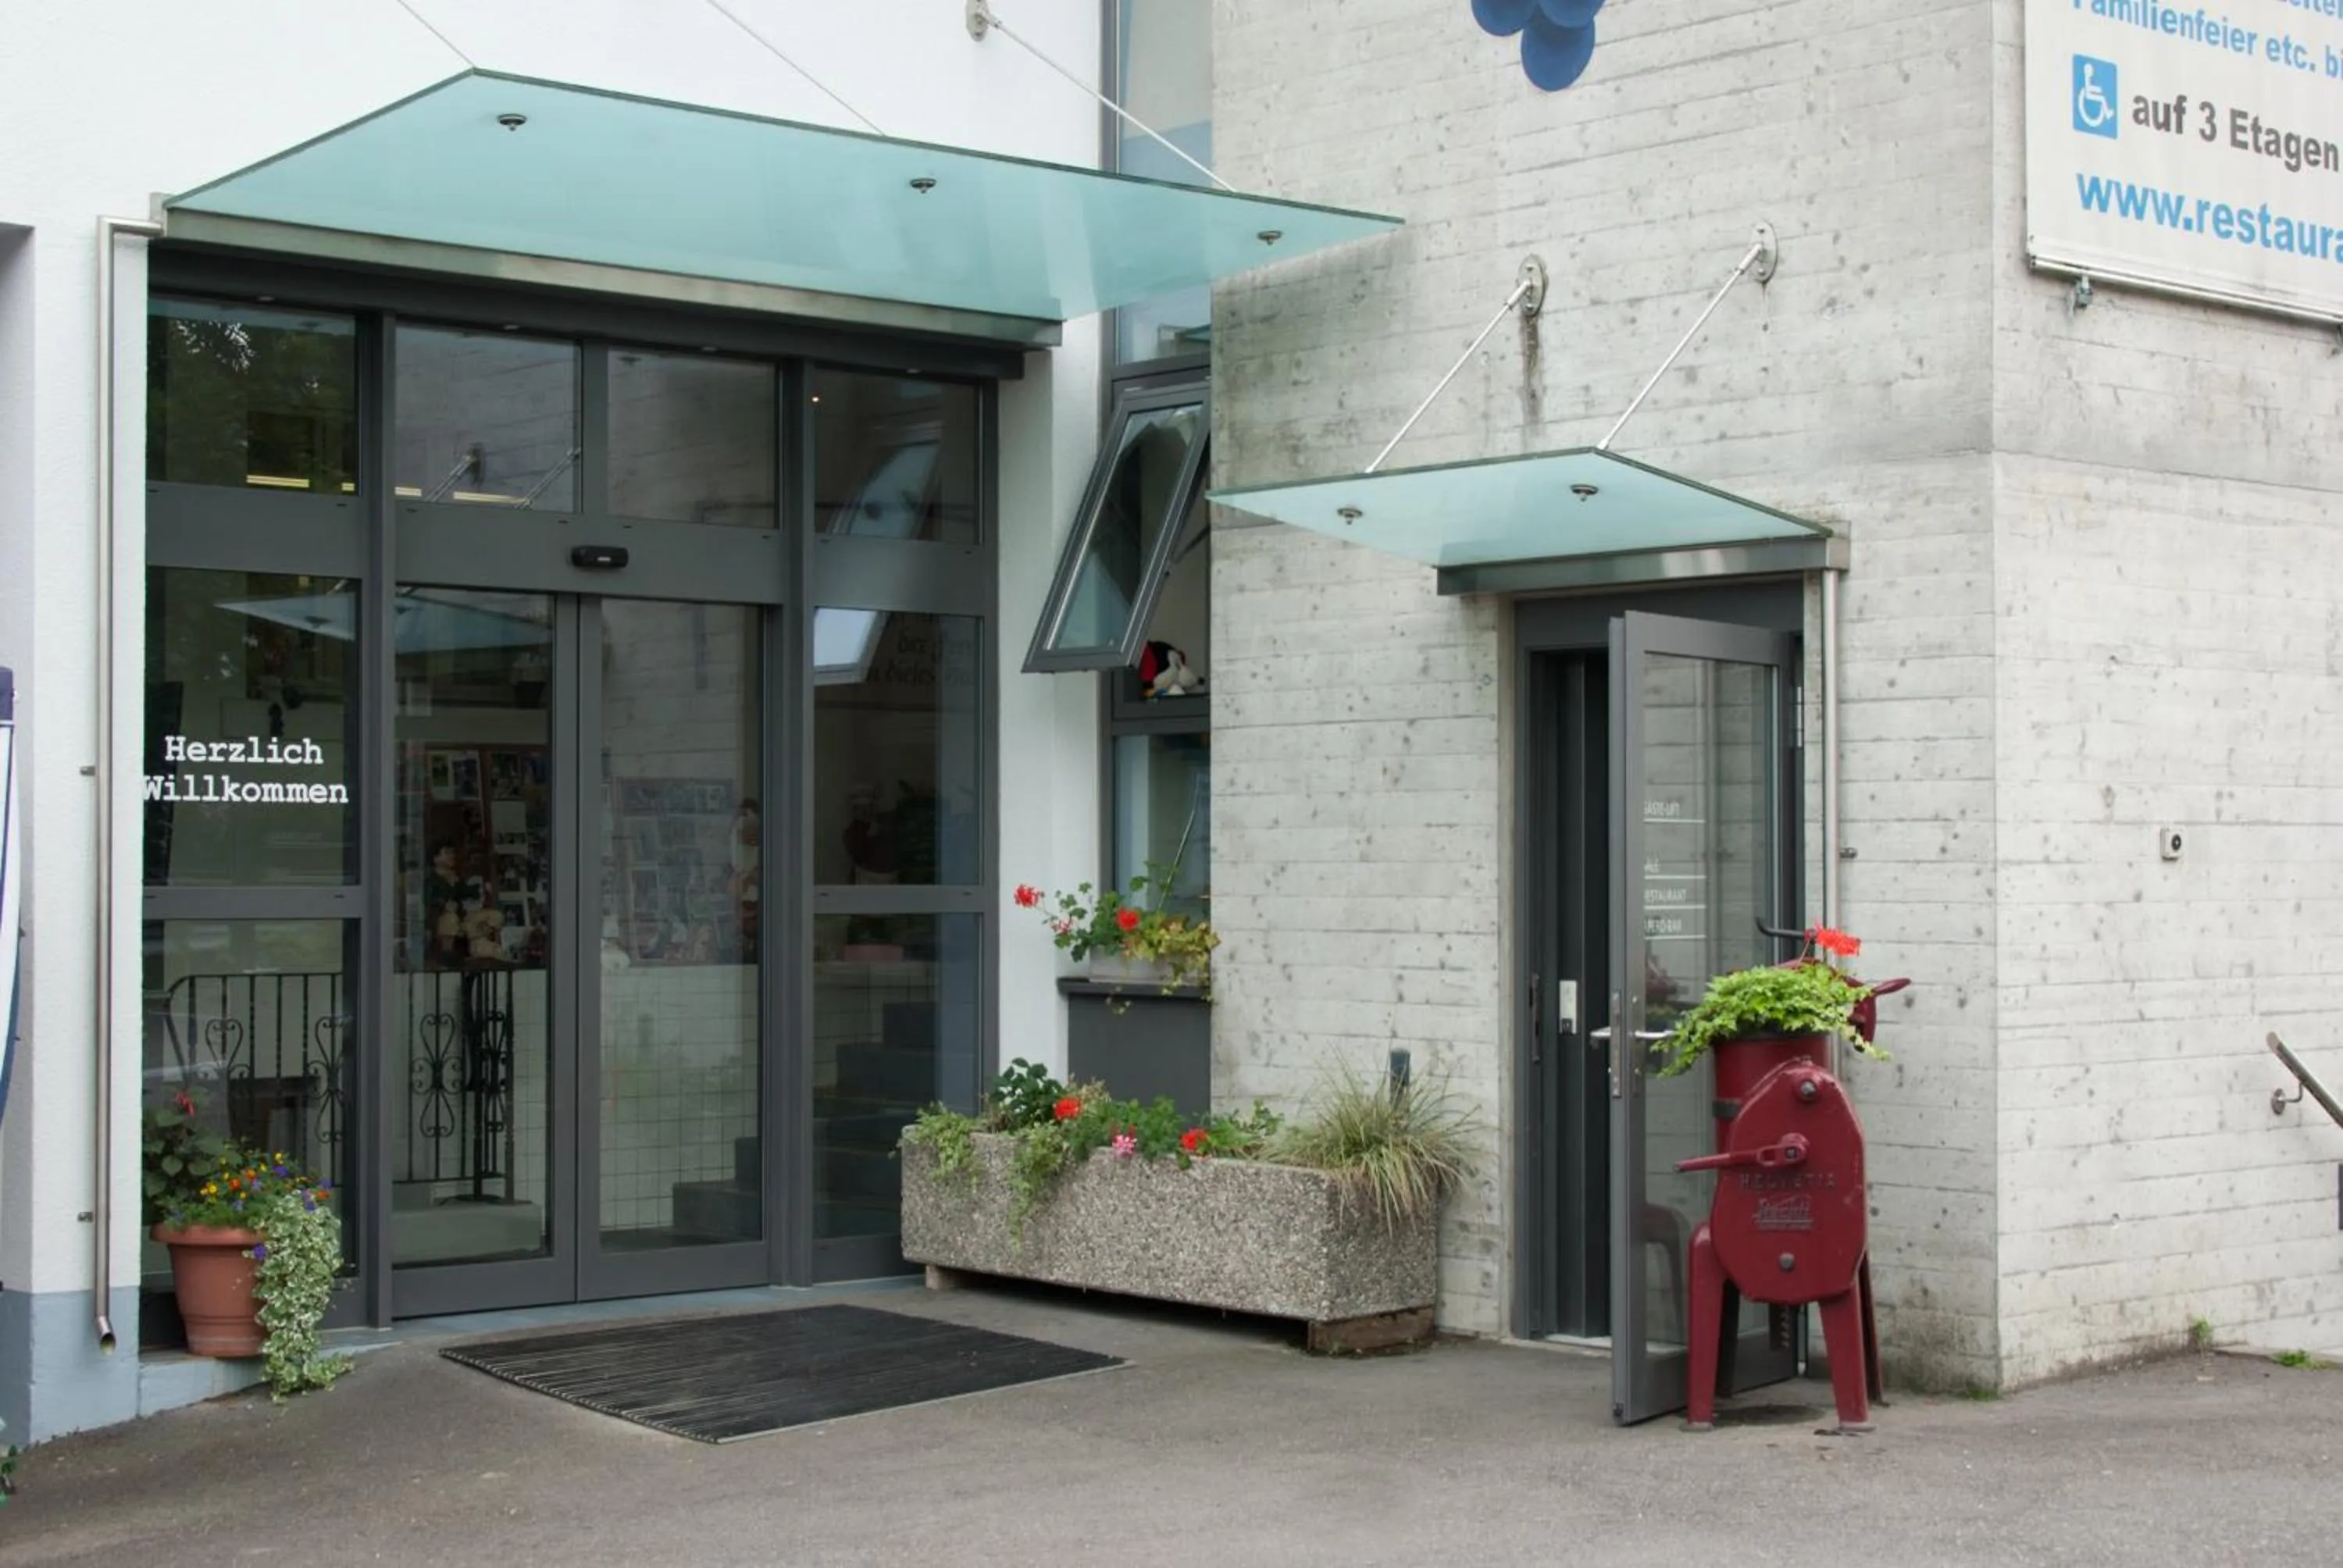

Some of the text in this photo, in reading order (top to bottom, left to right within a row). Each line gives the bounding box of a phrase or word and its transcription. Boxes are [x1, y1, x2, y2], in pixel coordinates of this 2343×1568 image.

[2266, 34, 2316, 73] etc.
[2132, 94, 2339, 173] auf 3 Etagen
[164, 735, 324, 764] Herzlich
[142, 774, 349, 804] Willkommen
